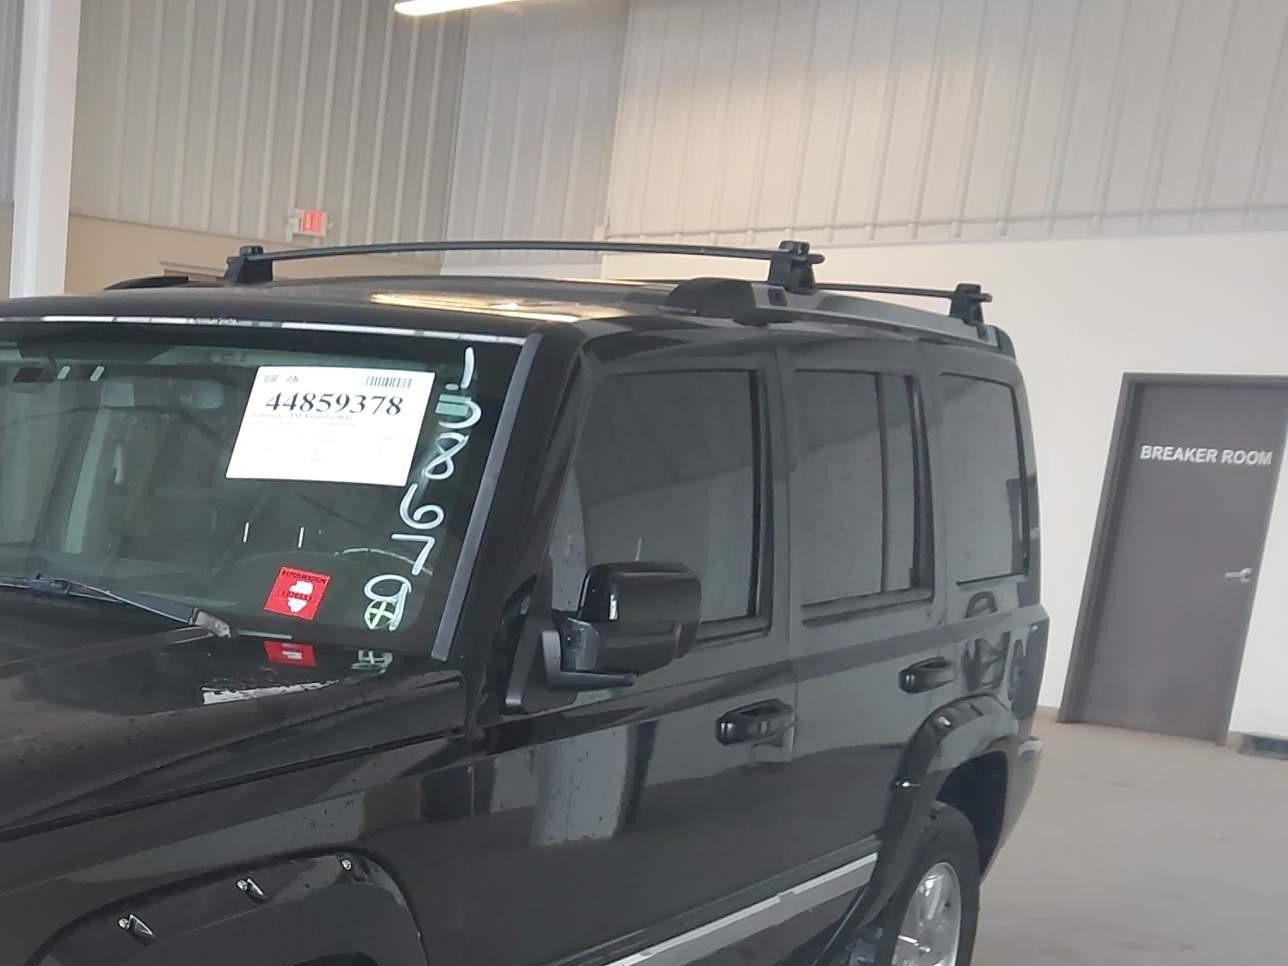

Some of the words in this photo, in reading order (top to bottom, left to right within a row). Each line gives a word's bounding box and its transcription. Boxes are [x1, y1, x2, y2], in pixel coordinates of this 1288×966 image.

[265, 391, 404, 417] 44859378
[1140, 445, 1218, 464] BREAKER
[1220, 450, 1274, 466] ROOM
